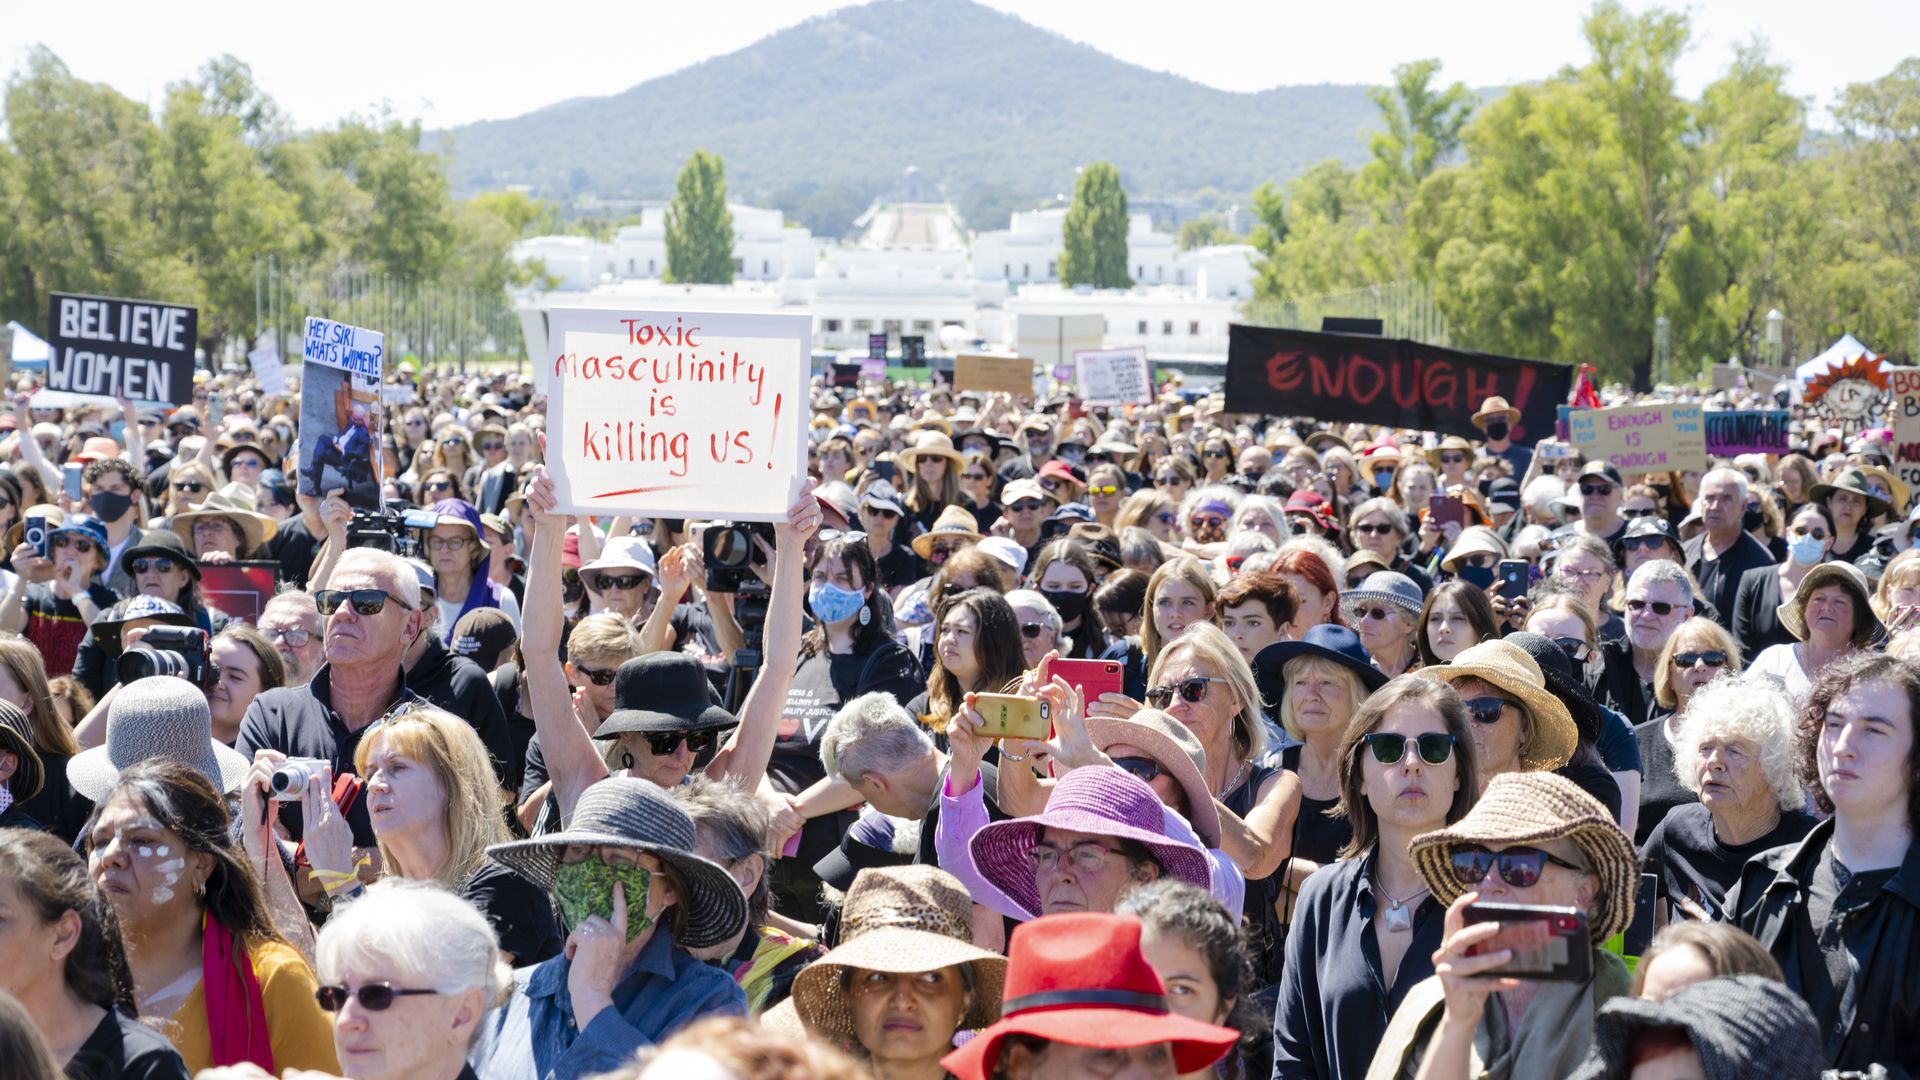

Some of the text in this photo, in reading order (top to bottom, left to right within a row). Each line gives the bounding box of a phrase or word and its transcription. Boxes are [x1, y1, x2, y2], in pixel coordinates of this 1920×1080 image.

[59, 298, 189, 351] BELIEVE
[309, 319, 329, 340] HEY
[620, 317, 703, 347] Toxic
[48, 345, 171, 402] WOMEN
[342, 345, 382, 375] WOMEN?
[555, 351, 765, 406] masculinity
[650, 388, 676, 417] is
[1266, 350, 1537, 441] ENOUGH!
[1607, 411, 1663, 431] ENOUGH
[1705, 414, 1790, 449] CCOUNTABLE
[584, 420, 689, 477] killing
[1624, 431, 1642, 447] IS
[1610, 452, 1667, 469] ENOUGH
